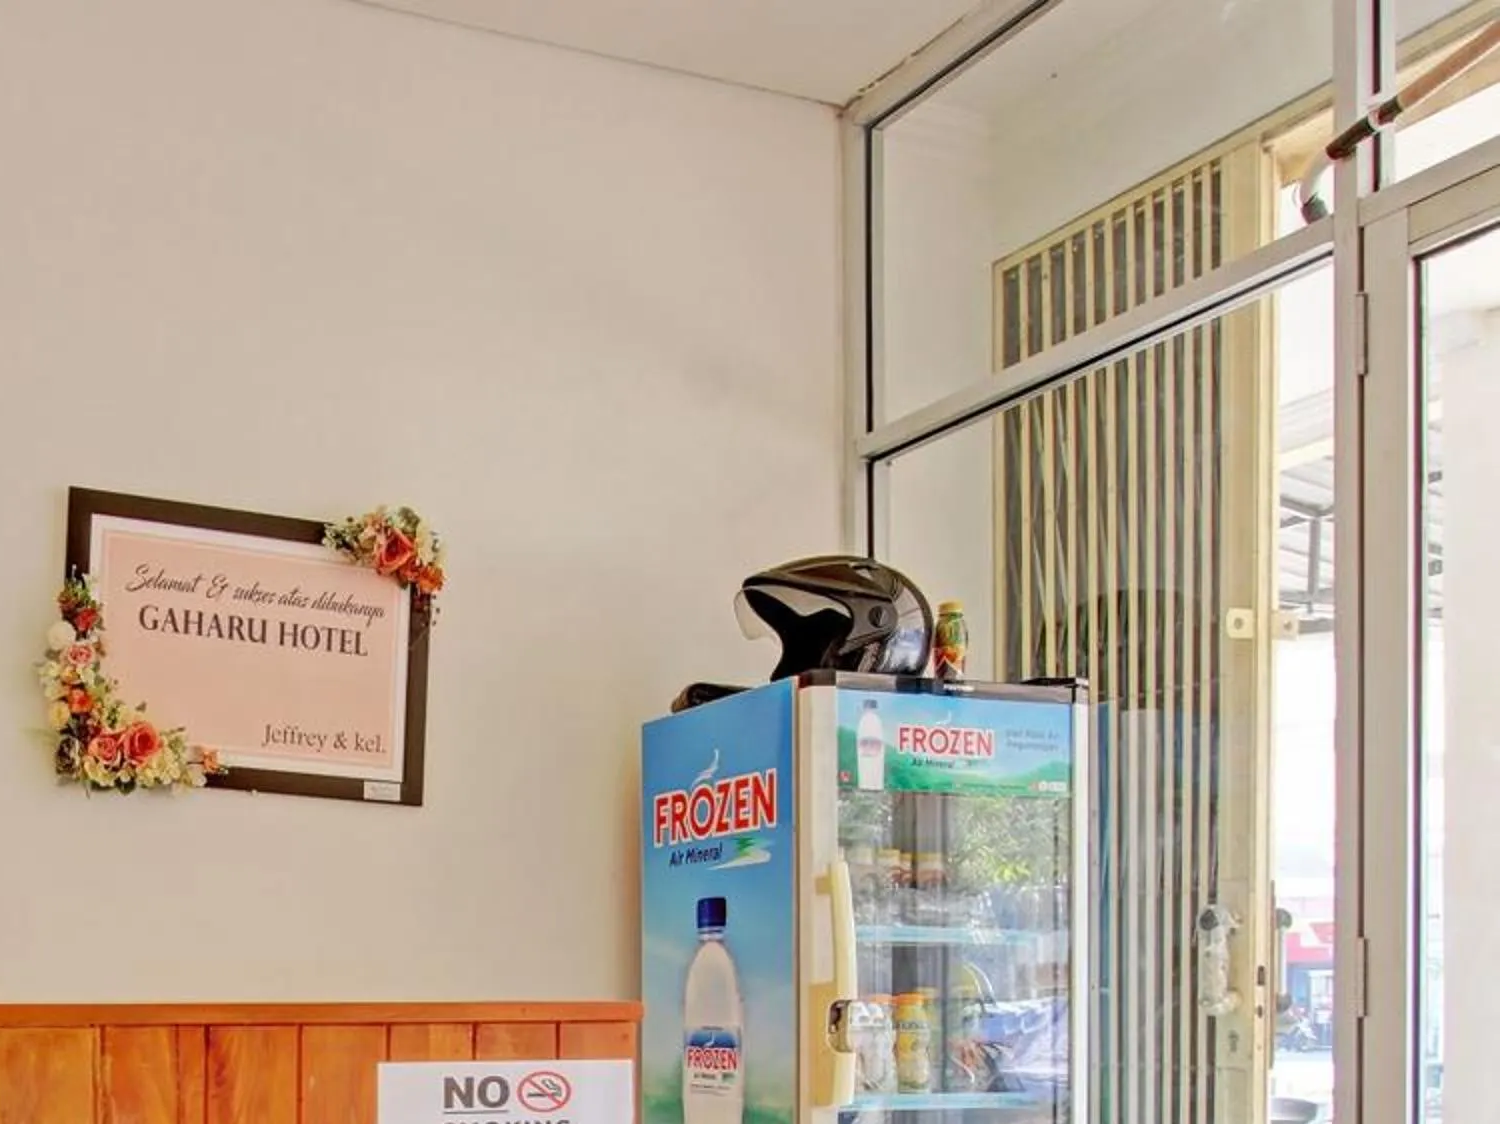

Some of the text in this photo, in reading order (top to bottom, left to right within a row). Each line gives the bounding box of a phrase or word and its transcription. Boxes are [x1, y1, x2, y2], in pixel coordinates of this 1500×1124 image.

[125, 563, 206, 593] Selamat
[232, 581, 277, 605] sukses
[278, 586, 310, 609] atas
[138, 603, 369, 657] GAHARU HOTEL
[261, 723, 328, 754] Jeffrey
[333, 730, 348, 751] &
[899, 726, 993, 757] FROZEN
[654, 768, 777, 848] FROZEN
[669, 841, 723, 868] Air Mineral
[686, 1048, 738, 1070] FROZEN
[443, 1075, 511, 1110] NO
